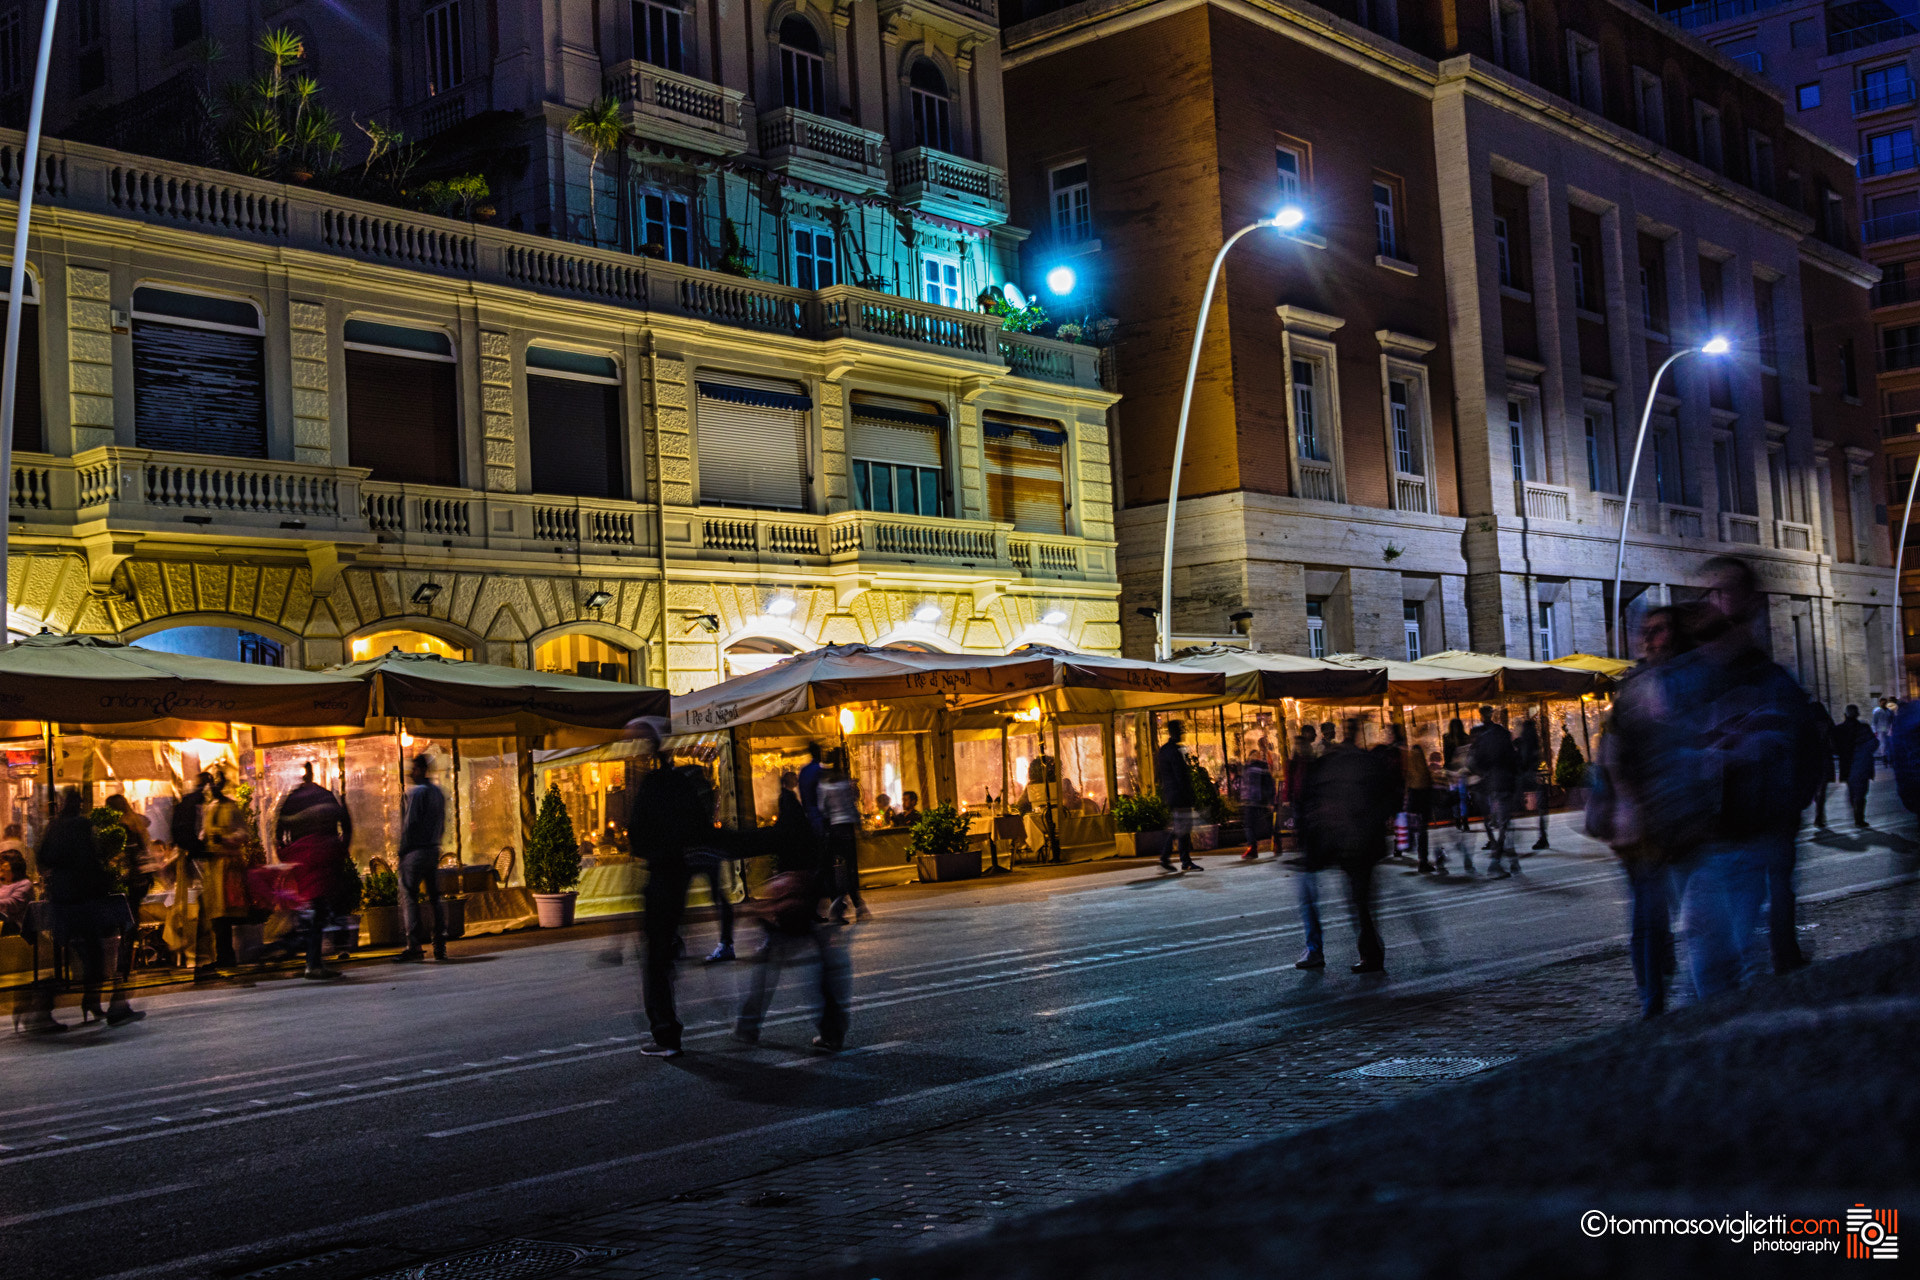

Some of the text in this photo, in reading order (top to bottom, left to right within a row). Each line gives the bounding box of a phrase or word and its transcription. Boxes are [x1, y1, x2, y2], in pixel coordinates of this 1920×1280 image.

[906, 670, 972, 691] I Re di Napoli
[685, 704, 739, 726] I Re di Napoli
